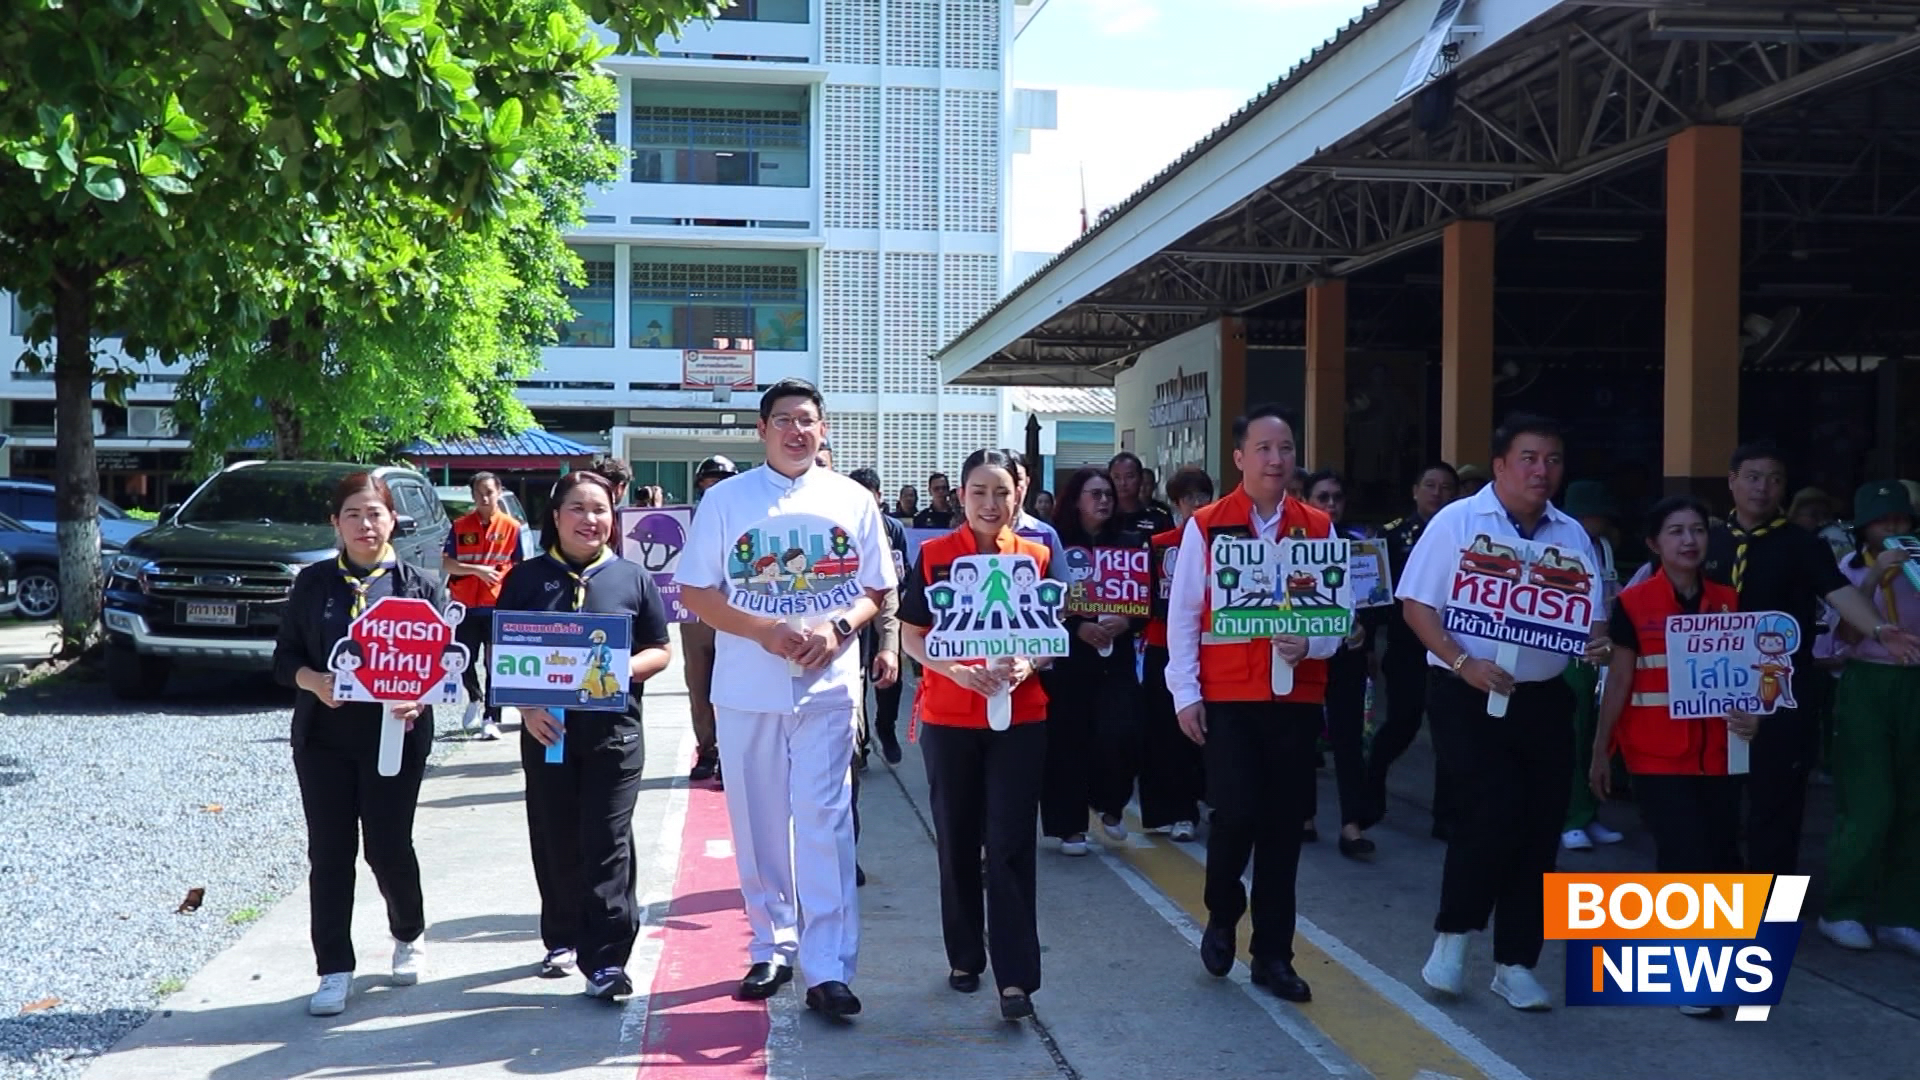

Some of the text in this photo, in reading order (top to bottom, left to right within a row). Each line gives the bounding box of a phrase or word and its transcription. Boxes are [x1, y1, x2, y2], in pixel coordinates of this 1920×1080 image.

[1094, 549, 1149, 579] หยุด
[1215, 536, 1347, 565] ข้าม ถนน
[733, 578, 860, 614] ถนนสร้างสุข
[1105, 578, 1138, 601] รถ
[1452, 572, 1592, 627] หยุดรถ
[361, 618, 443, 645] หยุดรถ
[1215, 612, 1347, 635] ข้ามทางม้าลาย
[1446, 607, 1586, 656] ให้ข้ามถนนหน่อย
[1670, 614, 1756, 633] สวมหมวก
[928, 634, 1067, 657] ข้ามทางม้าลาย
[1687, 632, 1745, 653] นิรภัย
[367, 641, 432, 680] ให้หนู
[496, 654, 541, 677] ลด
[1685, 656, 1749, 690] ใส่ใจ
[373, 676, 421, 694] หน่อย
